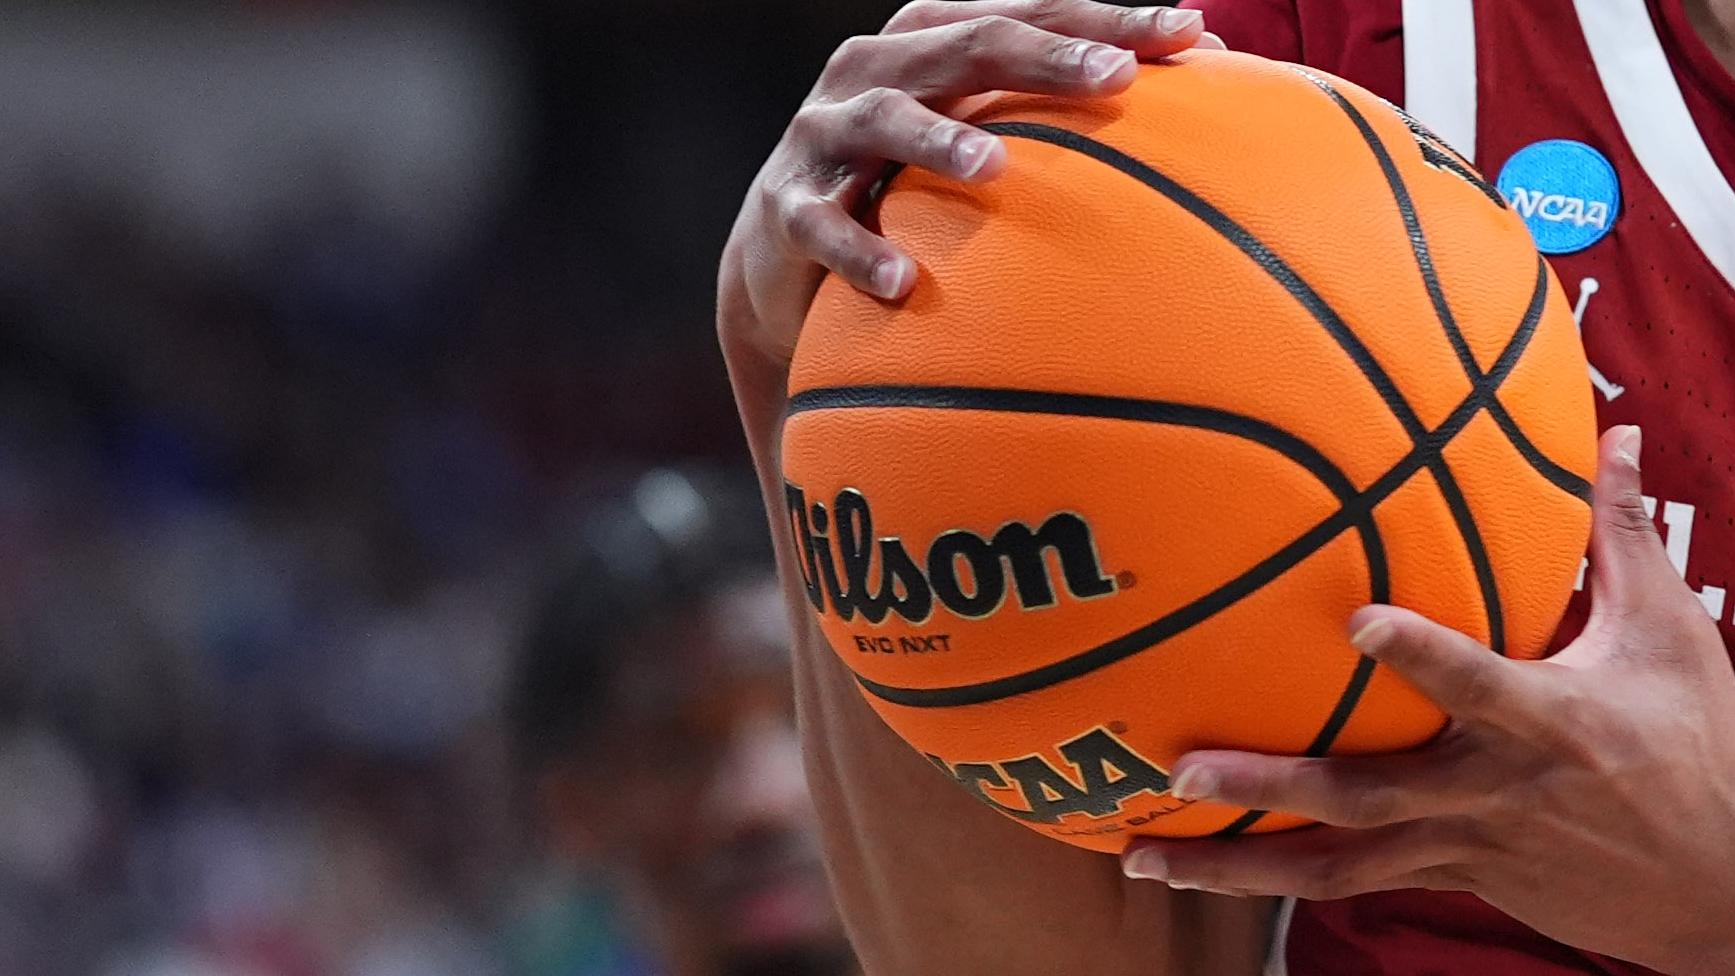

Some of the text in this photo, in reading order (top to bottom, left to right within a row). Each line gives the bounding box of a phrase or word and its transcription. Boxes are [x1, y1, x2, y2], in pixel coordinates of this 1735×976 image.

[1511, 186, 1609, 230] NCAA
[898, 633, 951, 655] NXT
[925, 726, 1172, 825] CAA
